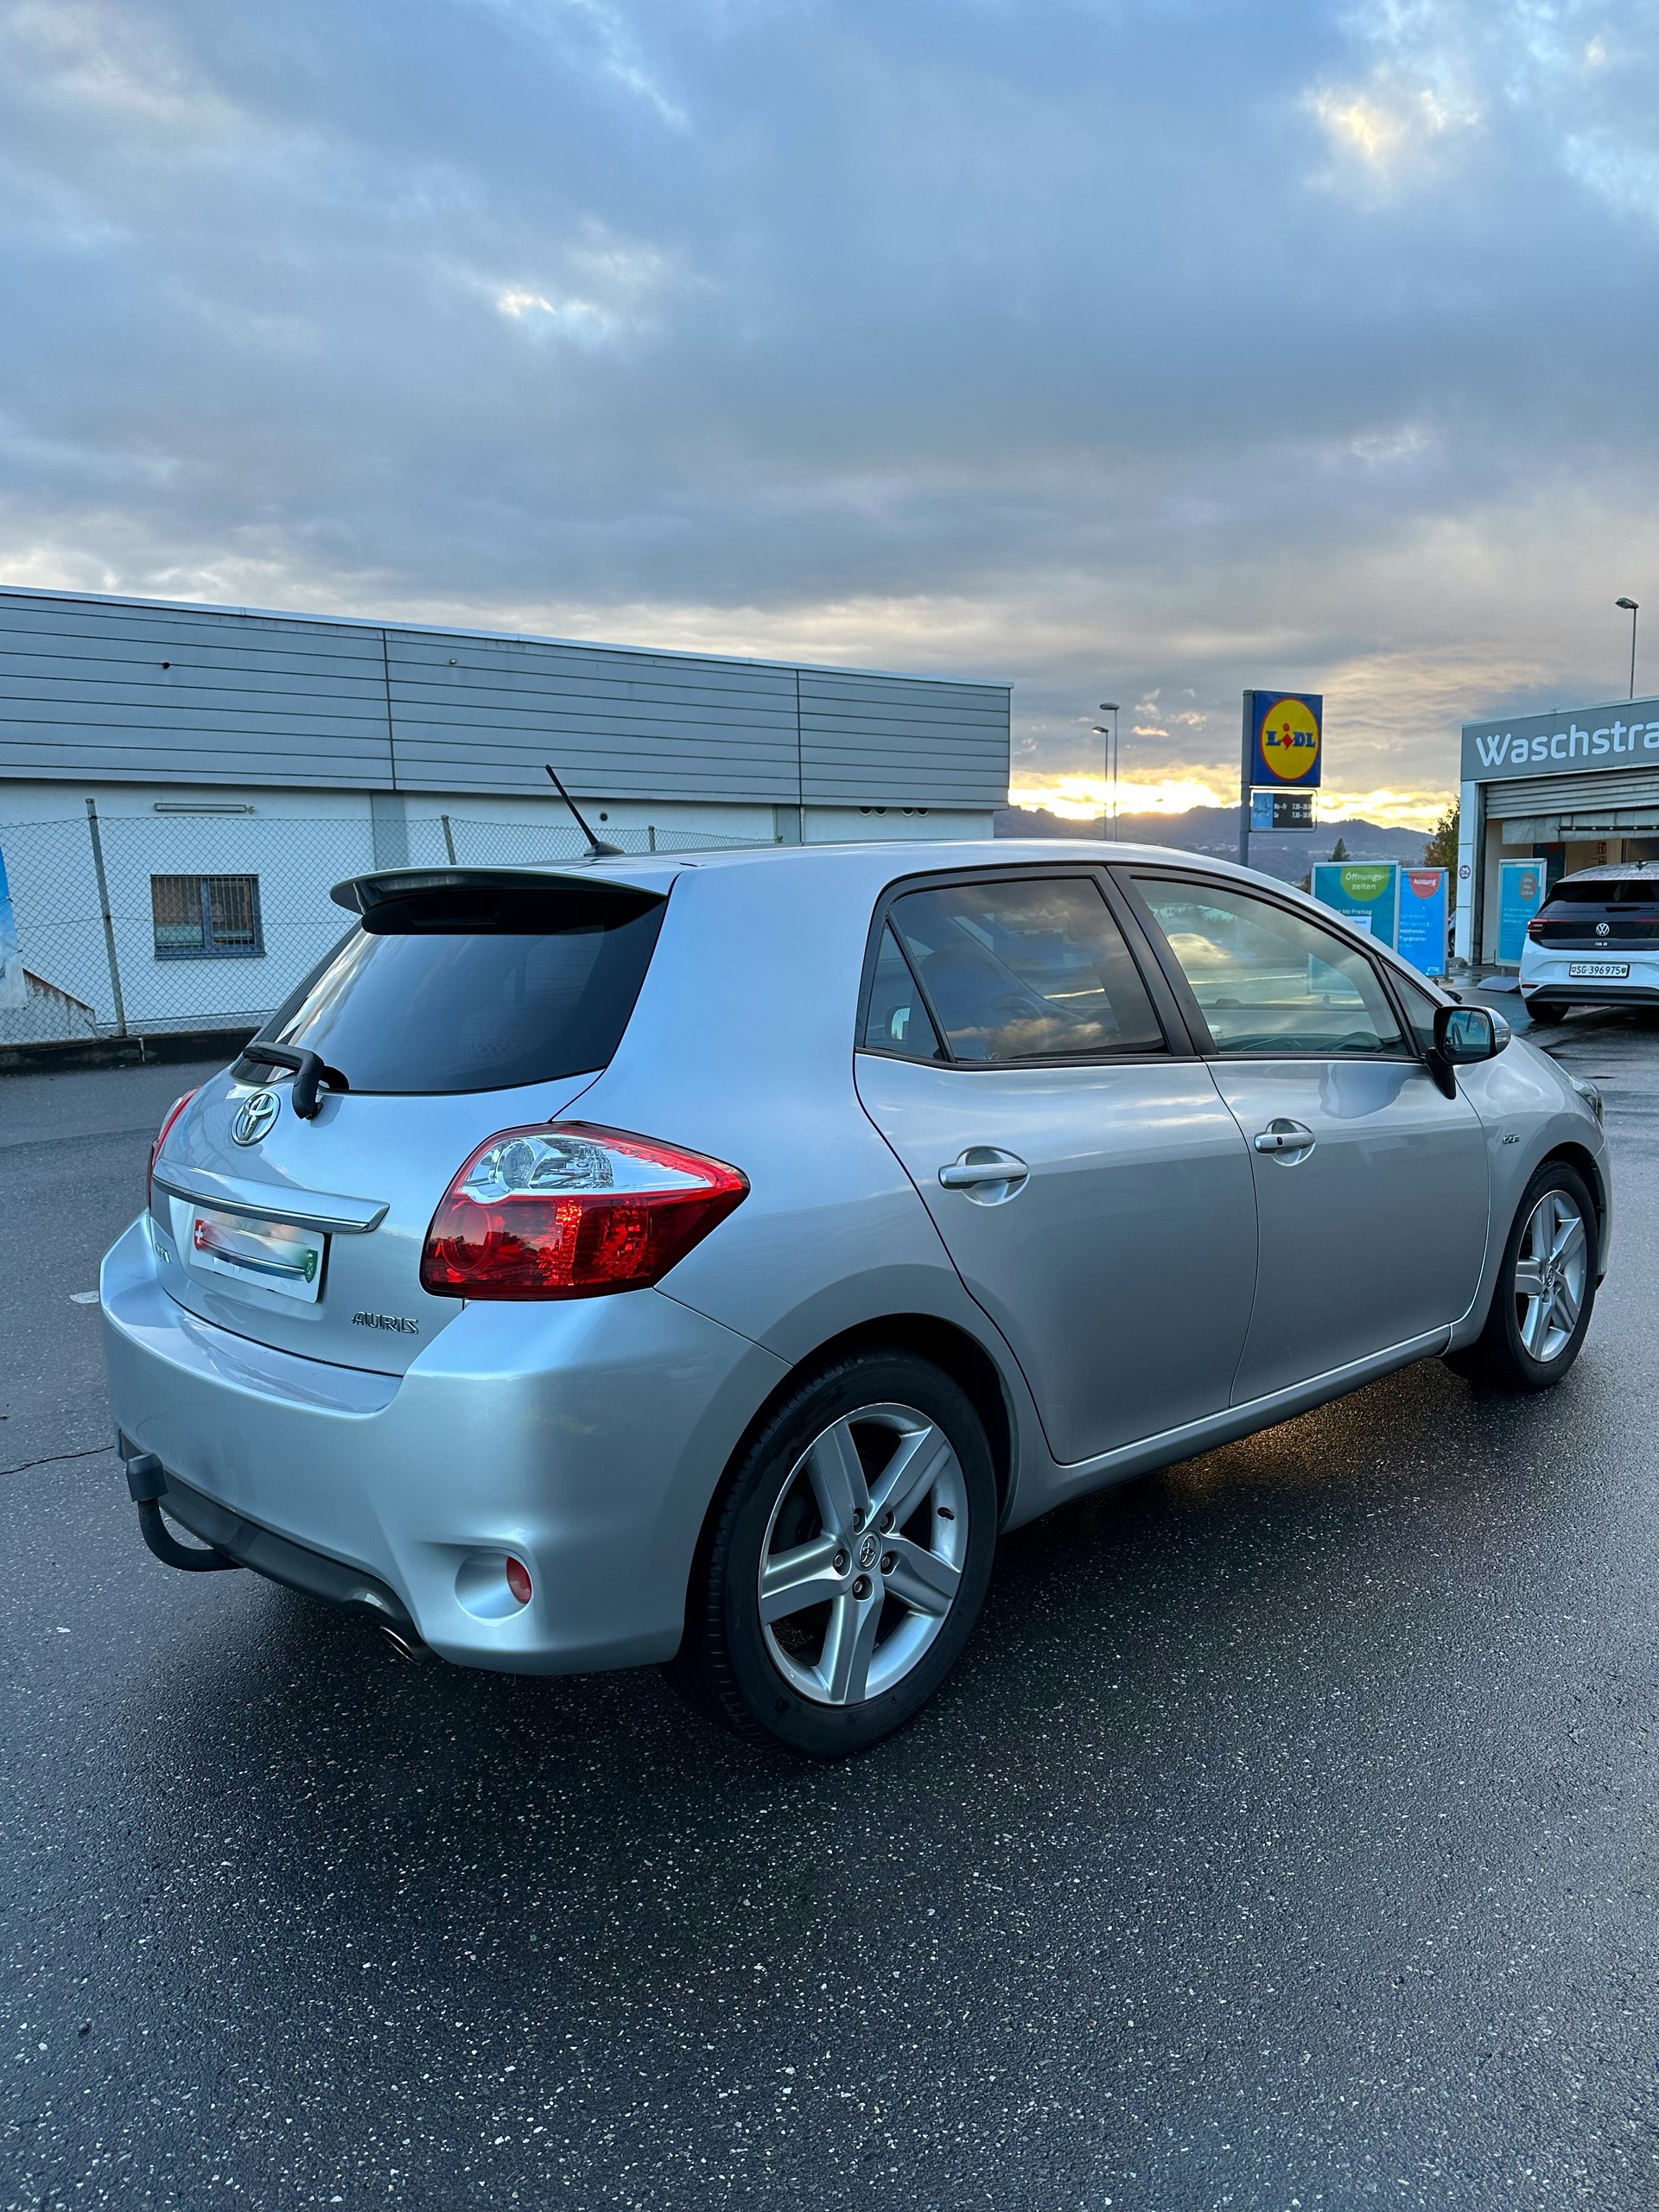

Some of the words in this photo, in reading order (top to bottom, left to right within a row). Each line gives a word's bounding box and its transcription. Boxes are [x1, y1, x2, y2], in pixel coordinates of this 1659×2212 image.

[1475, 721, 1659, 767] Waschstra
[1345, 872, 1384, 882] Öffnungs-
[1413, 878, 1437, 887] Achtung
[351, 1311, 419, 1335] AURIS
